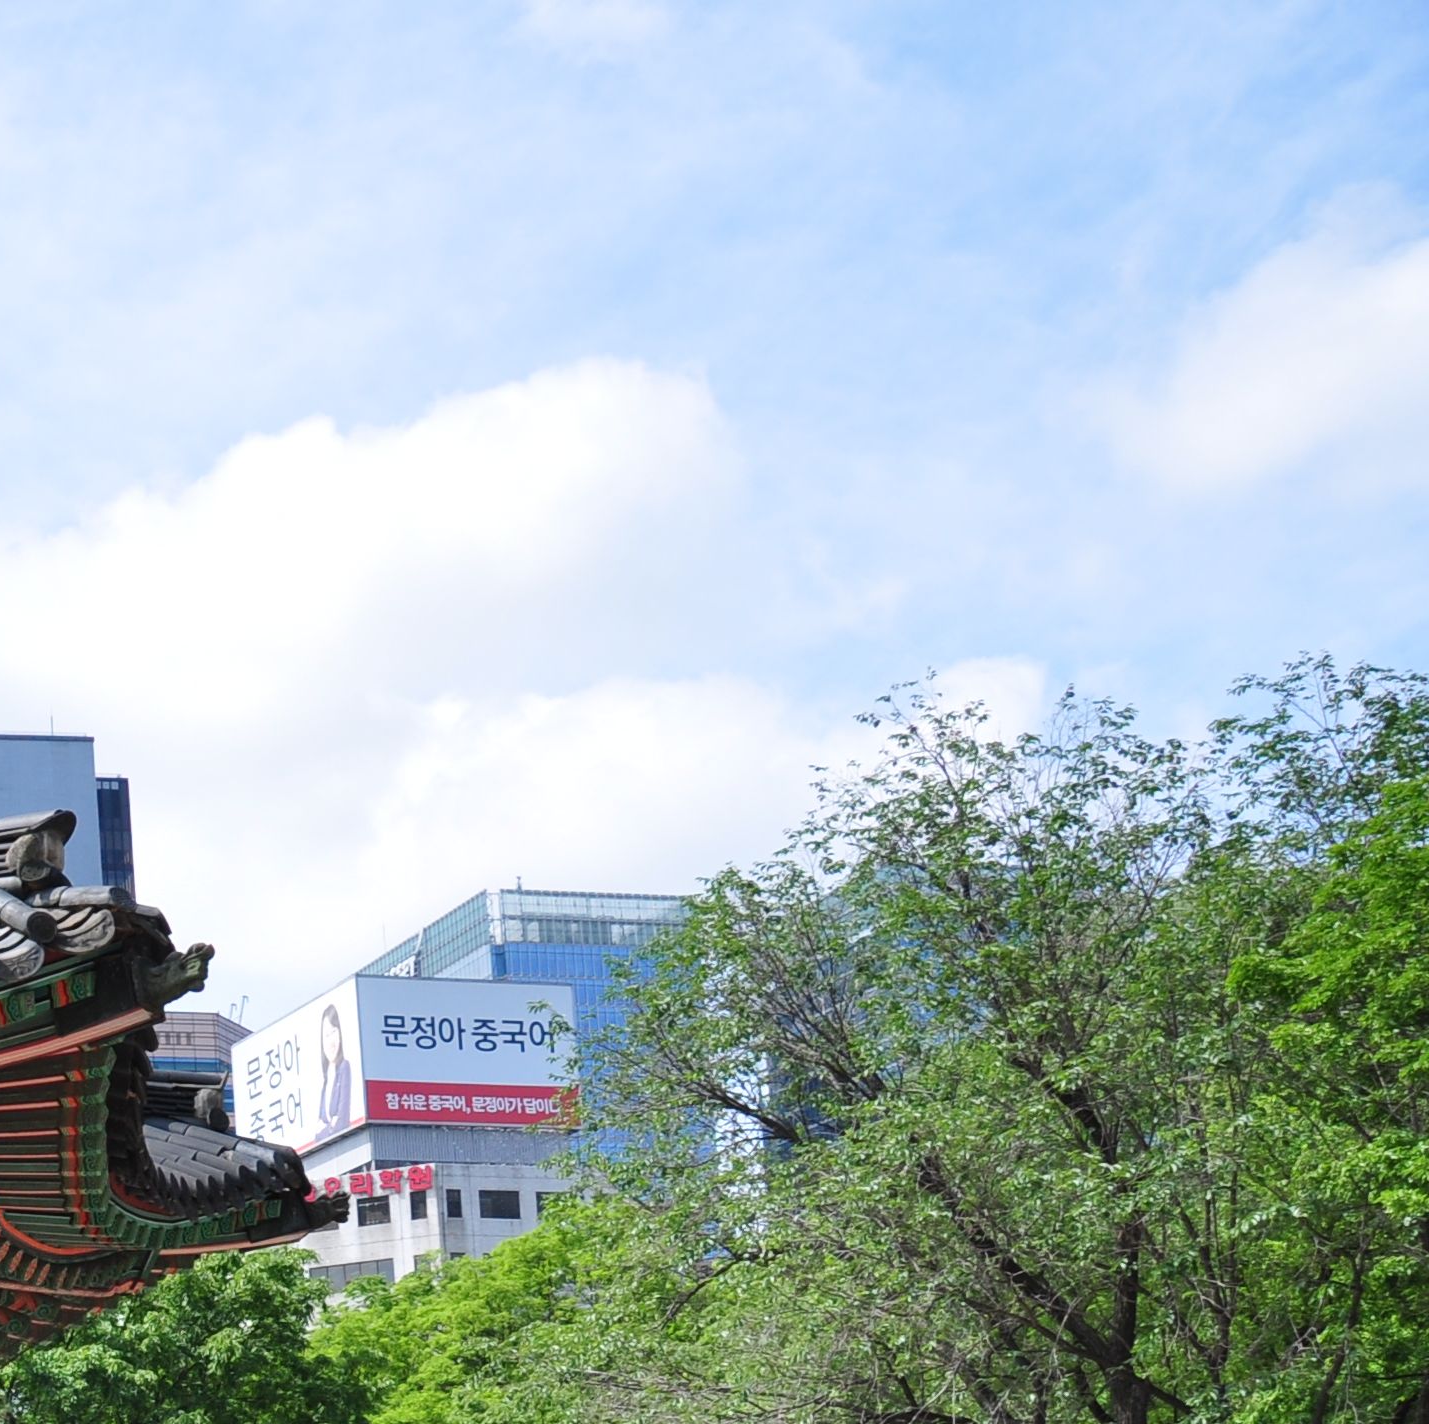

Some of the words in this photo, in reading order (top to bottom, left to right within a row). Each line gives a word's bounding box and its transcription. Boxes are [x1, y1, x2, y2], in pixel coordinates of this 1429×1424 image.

[381, 1015, 466, 1050] 문정아
[471, 1018, 555, 1053] 중국어
[247, 1034, 300, 1100] 문정아
[250, 1088, 303, 1141] 중국어
[401, 1093, 427, 1111] 쉬운
[428, 1095, 471, 1114] 중국어,
[472, 1096, 522, 1114] 문정아가
